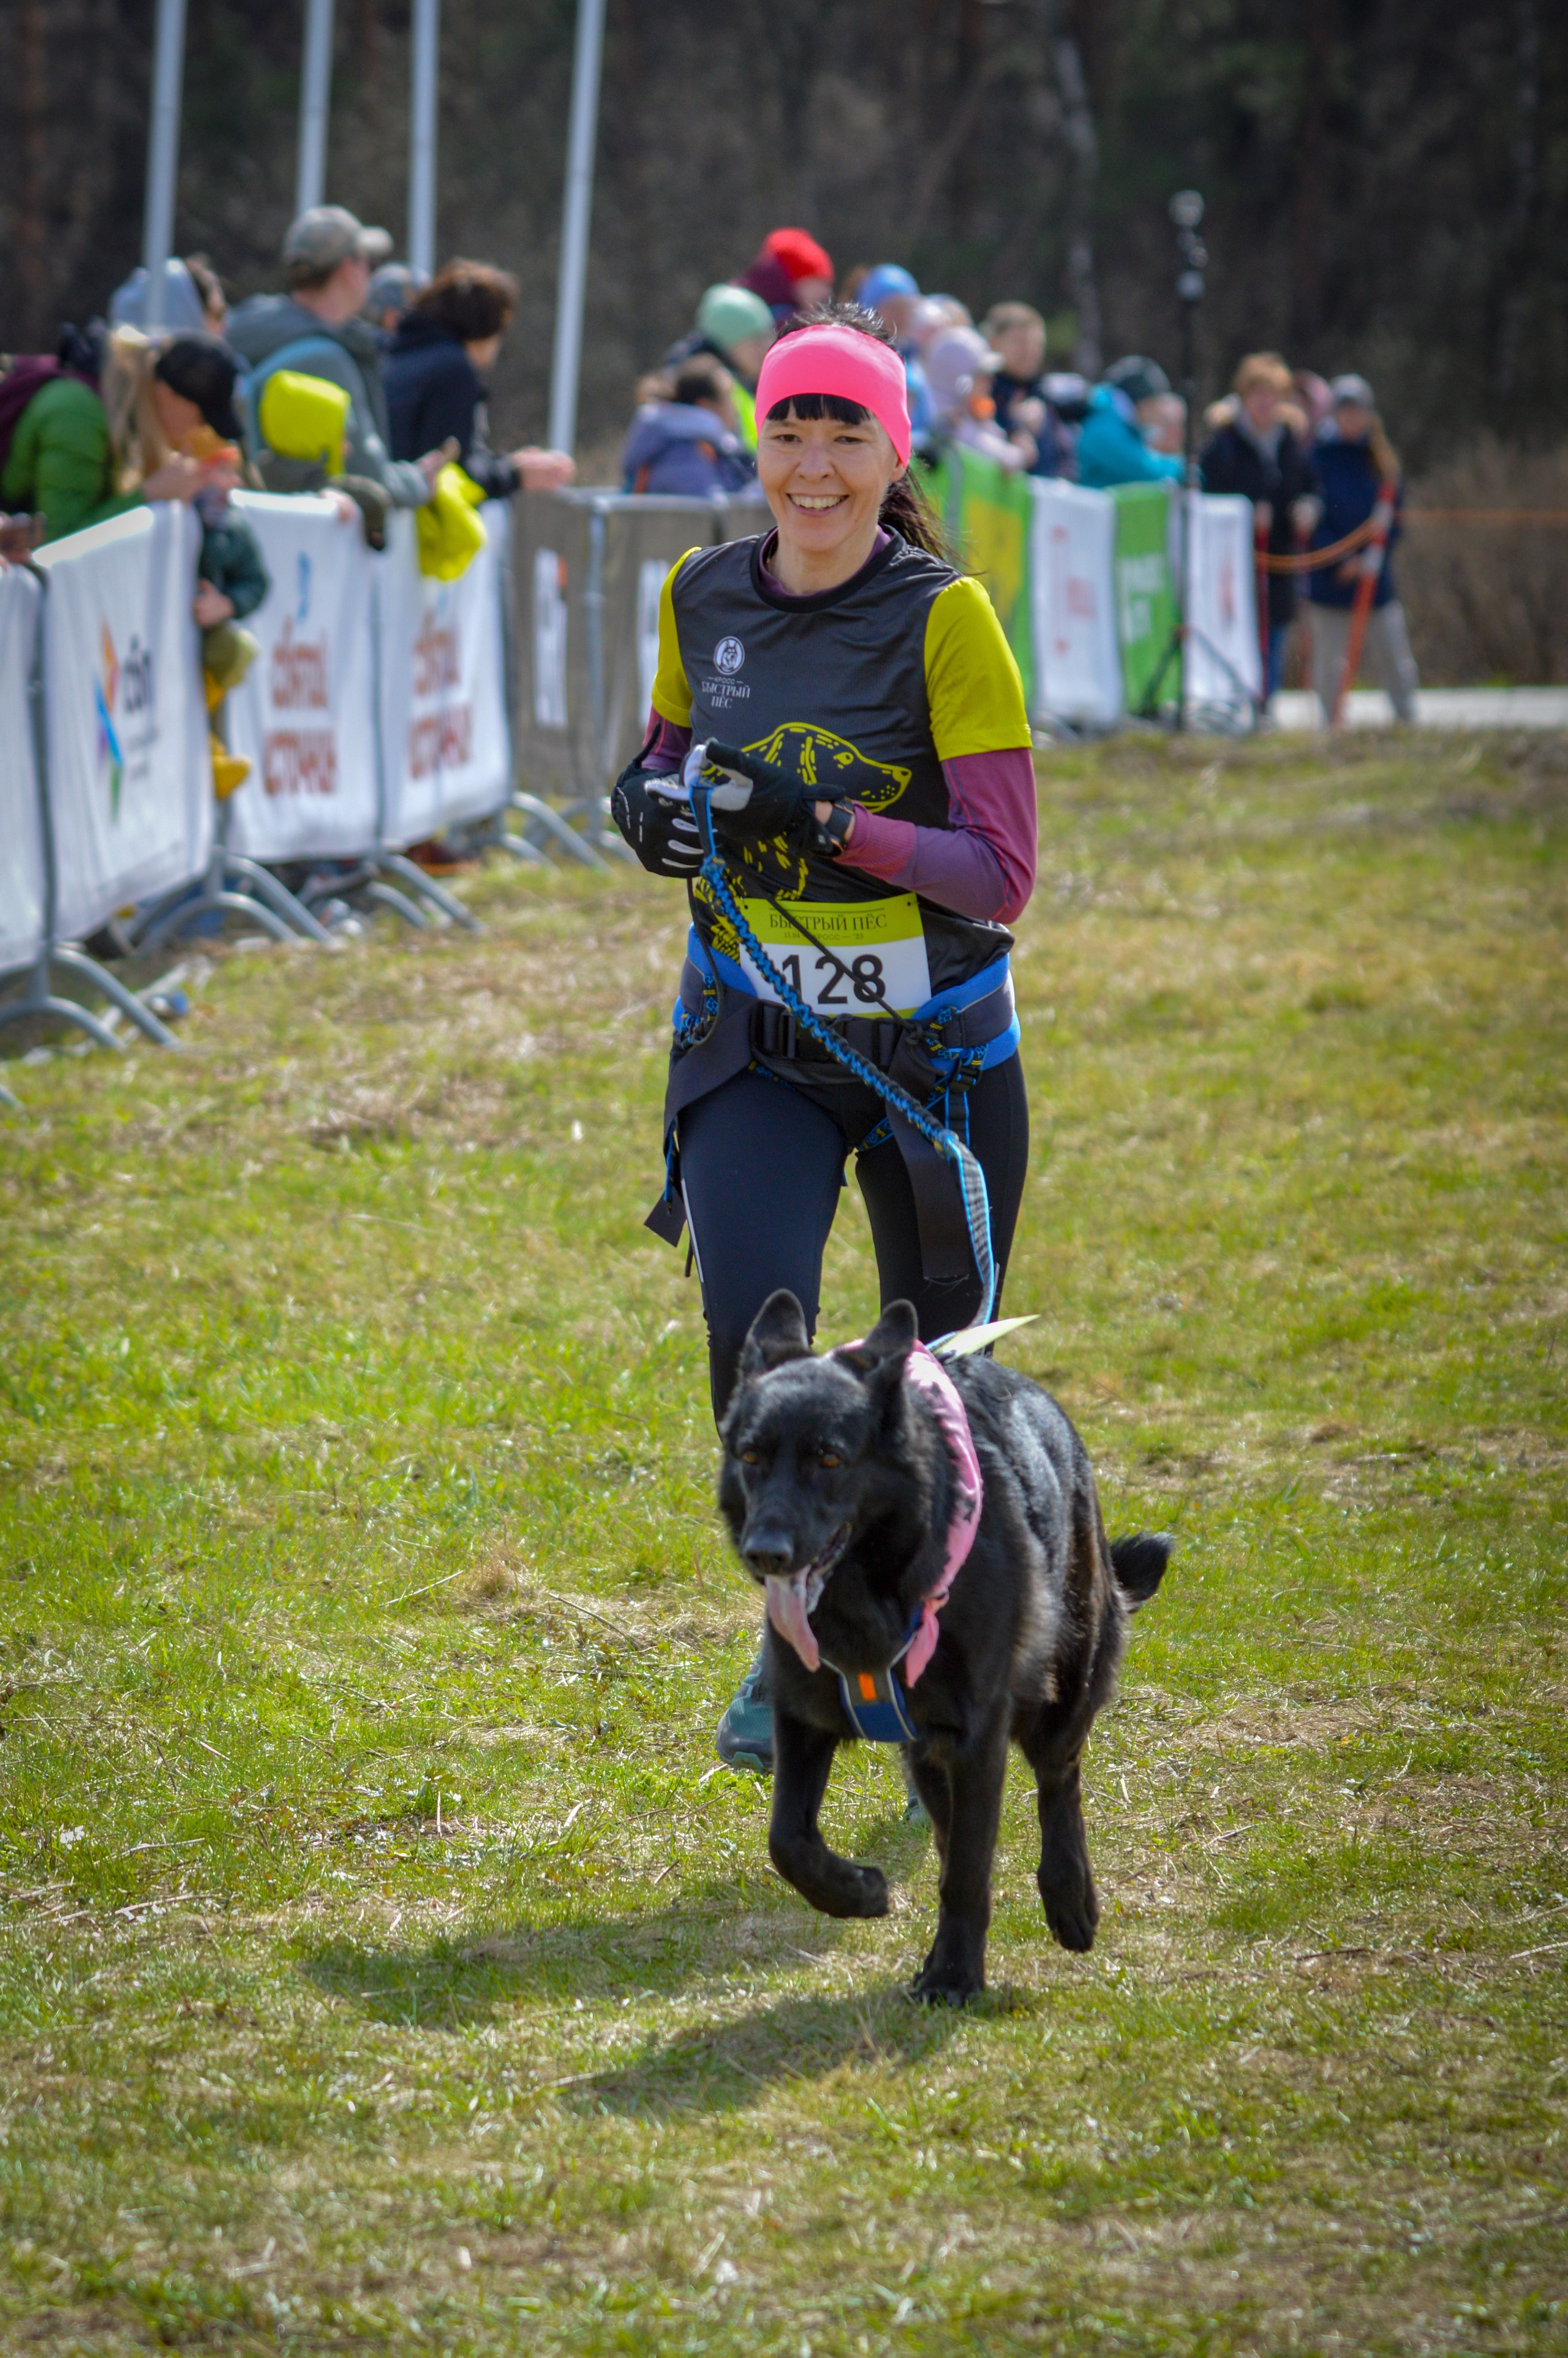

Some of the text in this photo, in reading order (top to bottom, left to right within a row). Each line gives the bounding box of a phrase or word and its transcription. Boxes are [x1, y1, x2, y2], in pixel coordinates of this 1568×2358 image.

[702, 681, 750, 698] БЫСТРЫЙ
[769, 913, 887, 931] БЫТРЫЙ ПЁС
[782, 954, 886, 1004] 128
